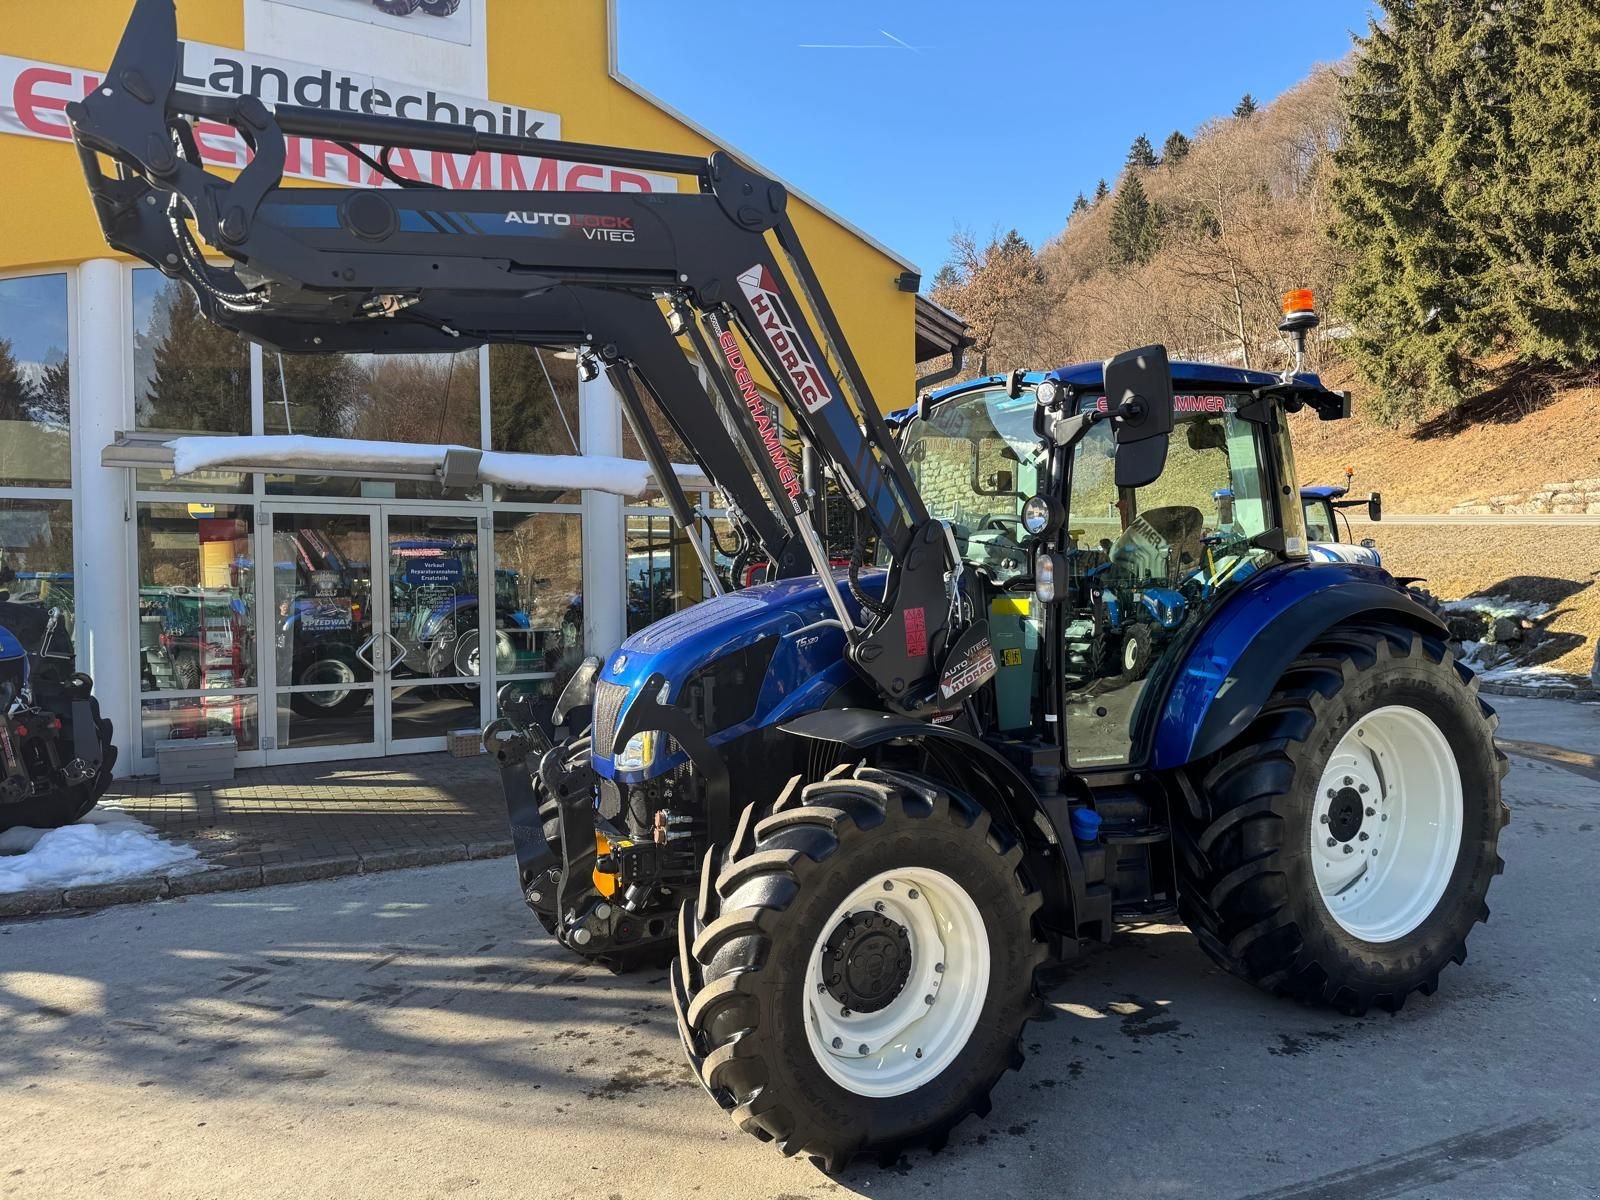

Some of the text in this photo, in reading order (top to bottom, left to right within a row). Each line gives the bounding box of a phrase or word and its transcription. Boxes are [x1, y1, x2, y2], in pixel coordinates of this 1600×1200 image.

[176, 41, 546, 138] Landtechnik
[750, 294, 818, 406] HYDRAC
[951, 661, 996, 693] HYDRAC
